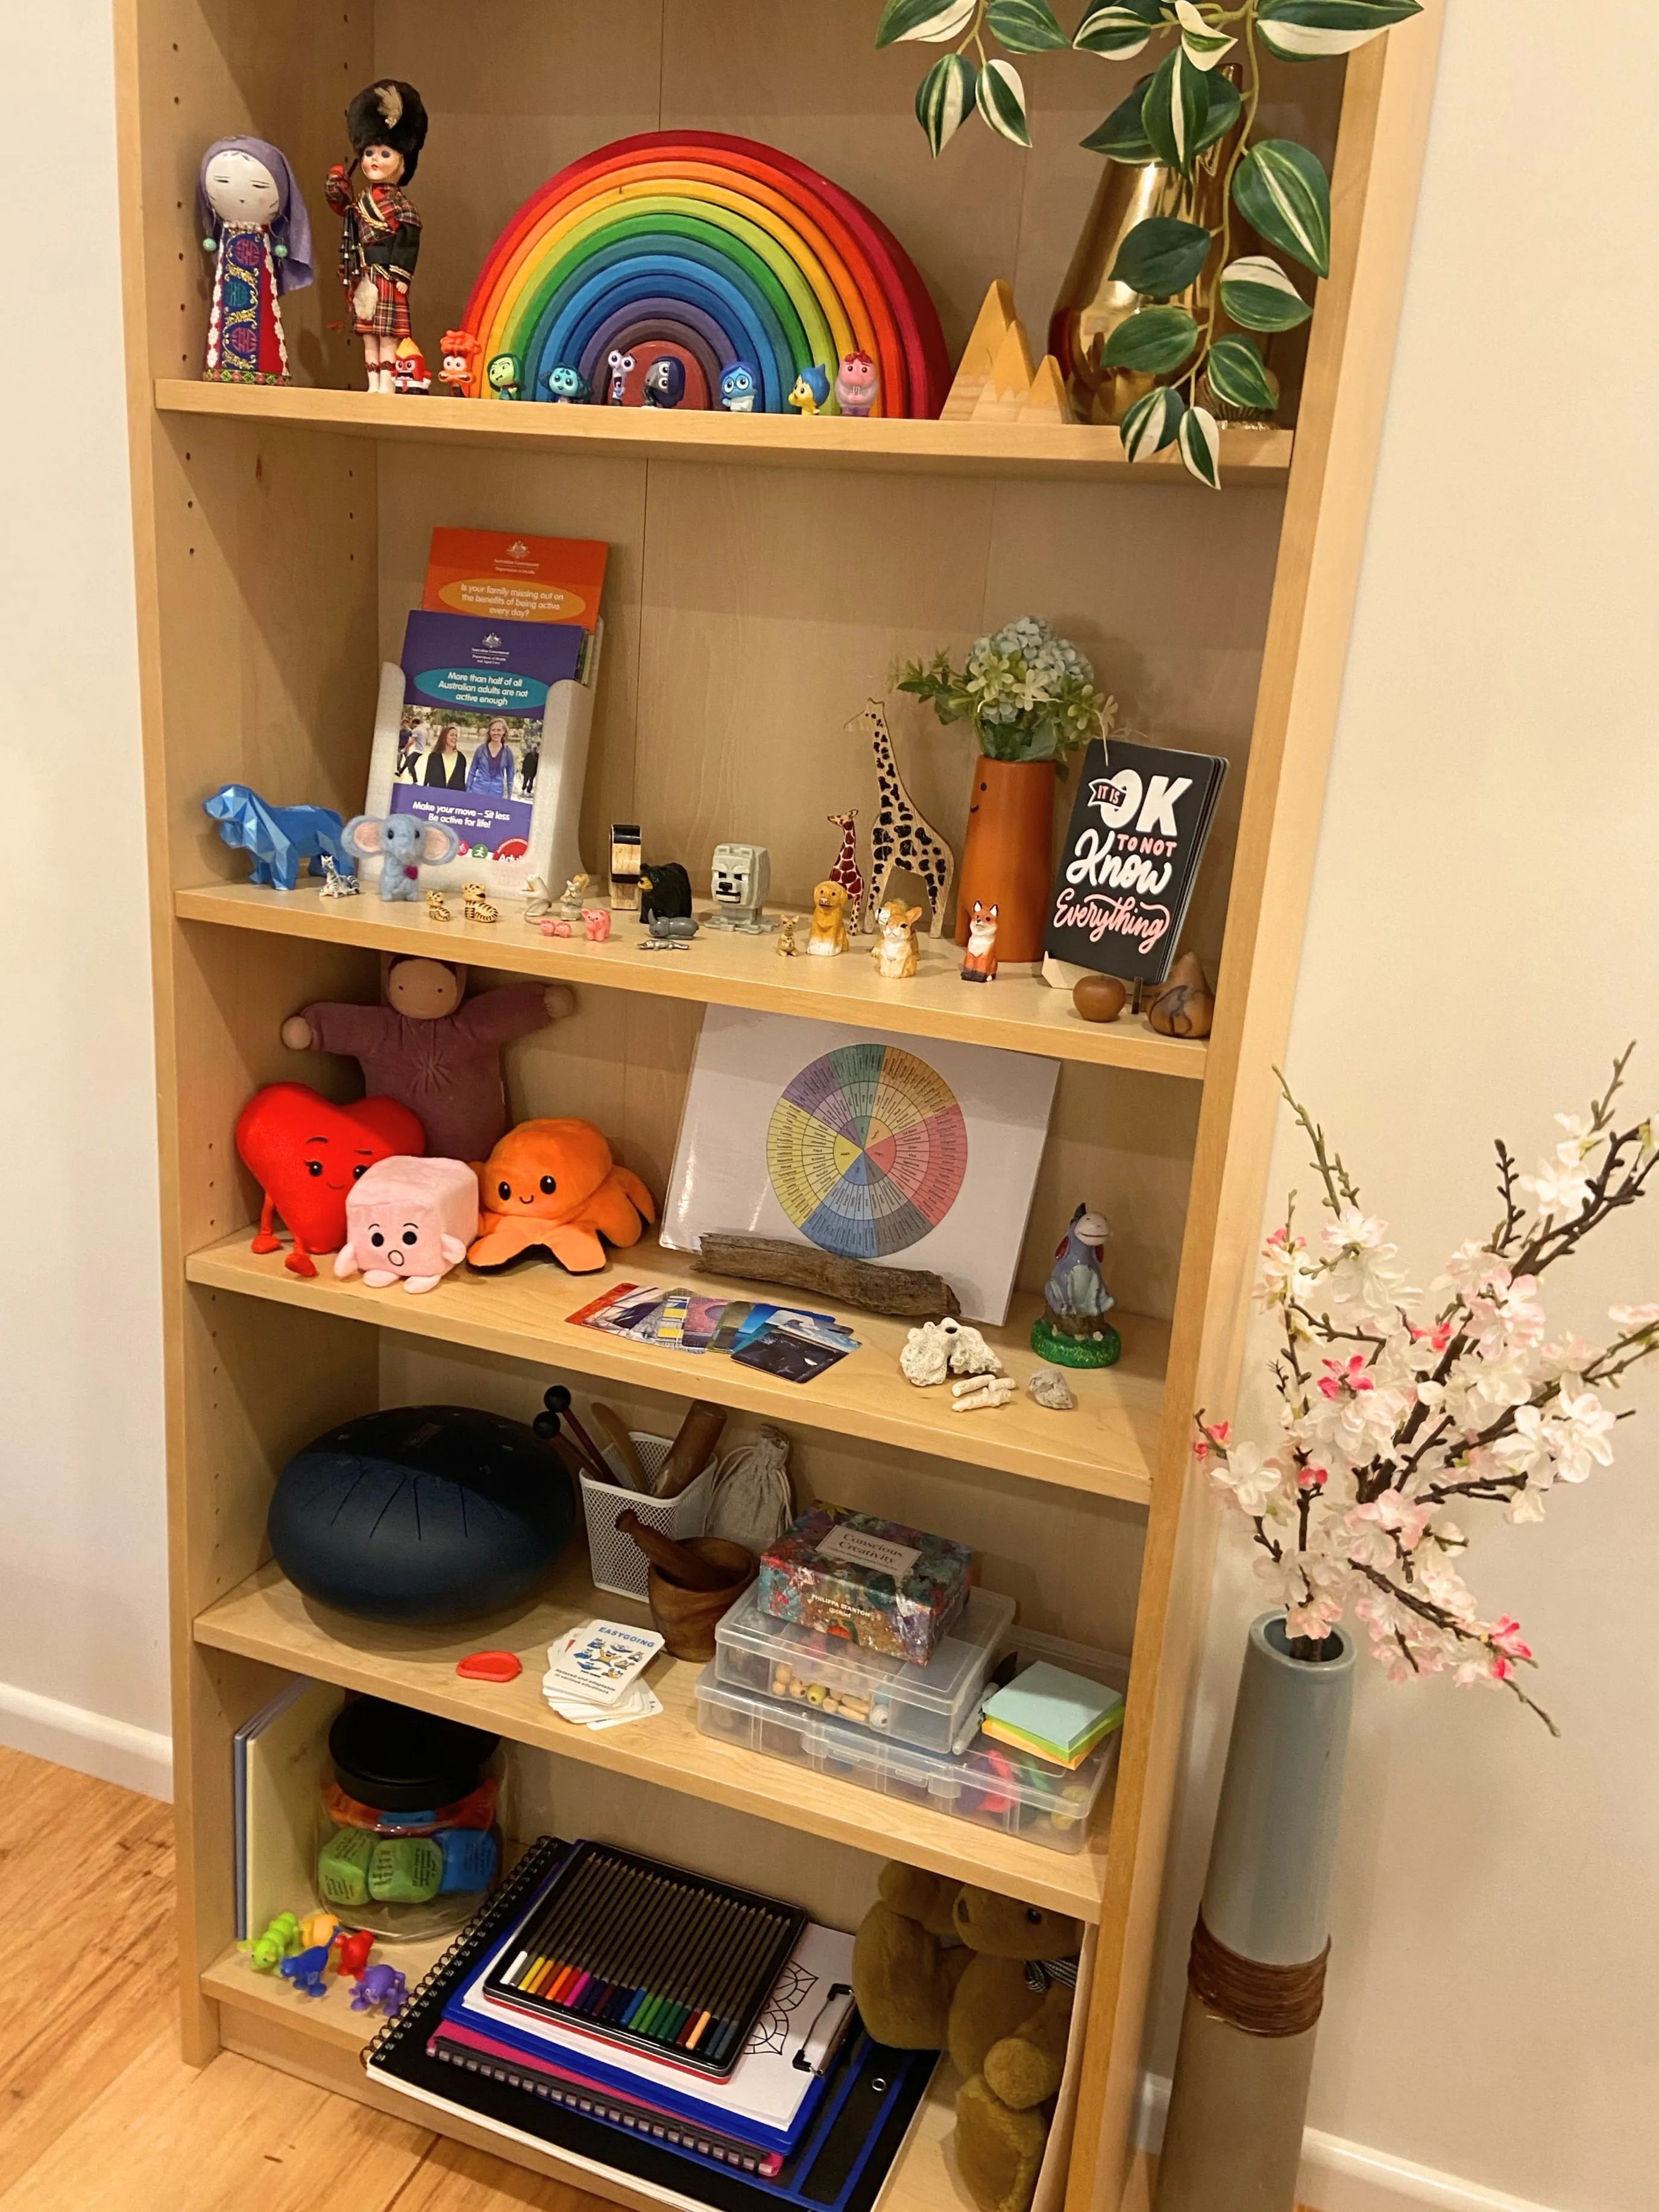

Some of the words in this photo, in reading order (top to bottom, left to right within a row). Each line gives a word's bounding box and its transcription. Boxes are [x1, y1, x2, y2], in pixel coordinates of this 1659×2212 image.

[469, 585, 485, 593] your
[486, 585, 509, 597] family
[511, 590, 538, 600] missing
[475, 594, 505, 605] benefits
[516, 599, 537, 610] being
[489, 608, 510, 616] every
[511, 608, 530, 618] day?
[438, 681, 476, 692] Australian
[477, 685, 500, 695] adults
[447, 671, 468, 681] More
[470, 674, 486, 683] than
[488, 676, 503, 685] half
[456, 693, 478, 702] active
[479, 696, 508, 707] enough
[1096, 785, 1108, 800] IT
[1110, 790, 1120, 805] IS
[1101, 769, 1193, 837] OK
[412, 801, 435, 811] Make
[436, 805, 455, 814] your
[455, 808, 476, 816] move
[483, 810, 494, 819] Sit
[495, 811, 510, 821] less
[428, 813, 439, 822] Be
[440, 815, 463, 825] active
[464, 818, 476, 826] for
[476, 819, 491, 828] life!
[1117, 833, 1136, 851] TO
[1139, 837, 1177, 857] NOT
[1066, 828, 1172, 895] Know
[1053, 887, 1170, 954] Everything
[839, 1541, 895, 1564] Creativity
[844, 1533, 902, 1557] Conscious
[811, 1594, 839, 1608] PHILIPPA
[840, 1603, 871, 1618] STANTON
[598, 1627, 655, 1648] EASYGOING
